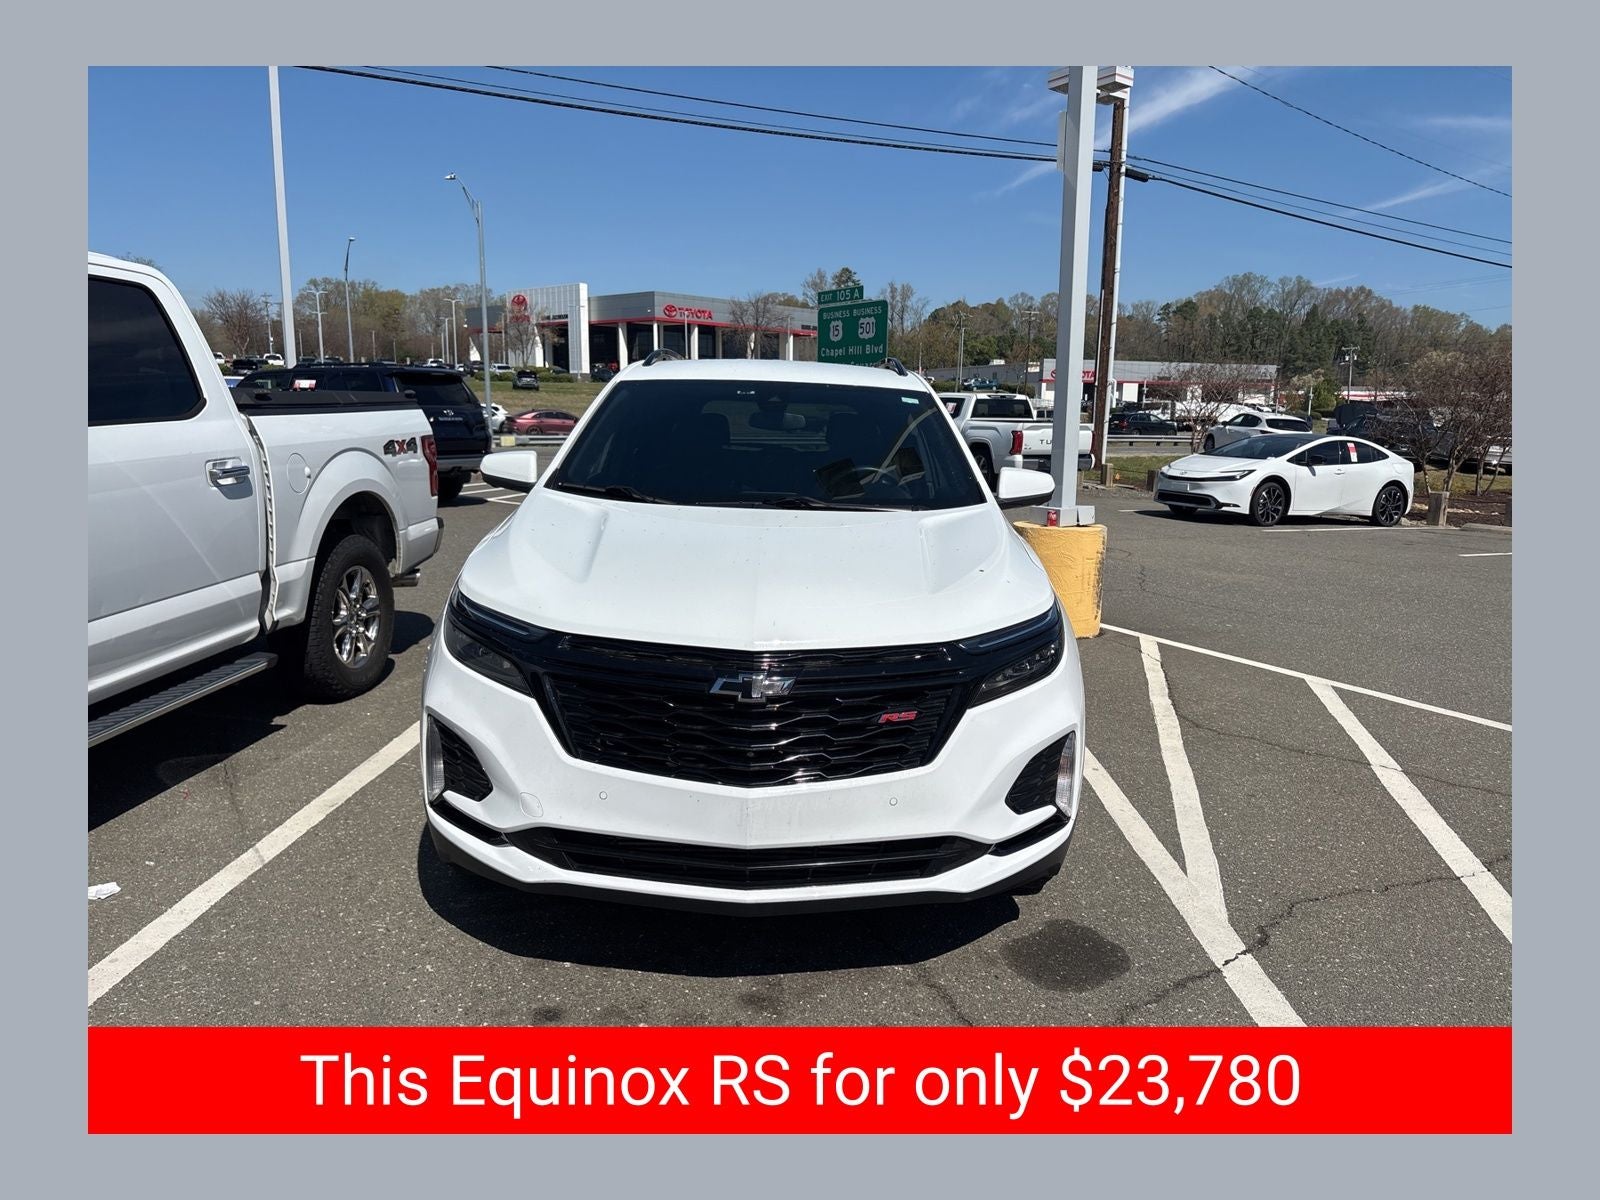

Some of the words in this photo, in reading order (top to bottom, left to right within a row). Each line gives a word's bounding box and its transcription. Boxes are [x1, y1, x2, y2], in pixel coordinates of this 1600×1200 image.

[820, 293, 833, 302] EXIT
[836, 289, 851, 301] 105
[853, 289, 860, 299] A
[677, 306, 713, 321] TOYOTA
[823, 310, 850, 320] BUSINESS
[852, 306, 882, 317] BUSINESS
[832, 324, 840, 338] 15
[859, 321, 875, 335] 501
[820, 347, 846, 358] Chapel
[848, 345, 862, 356] Hill
[865, 343, 883, 354] Blvd
[878, 710, 918, 724] RS
